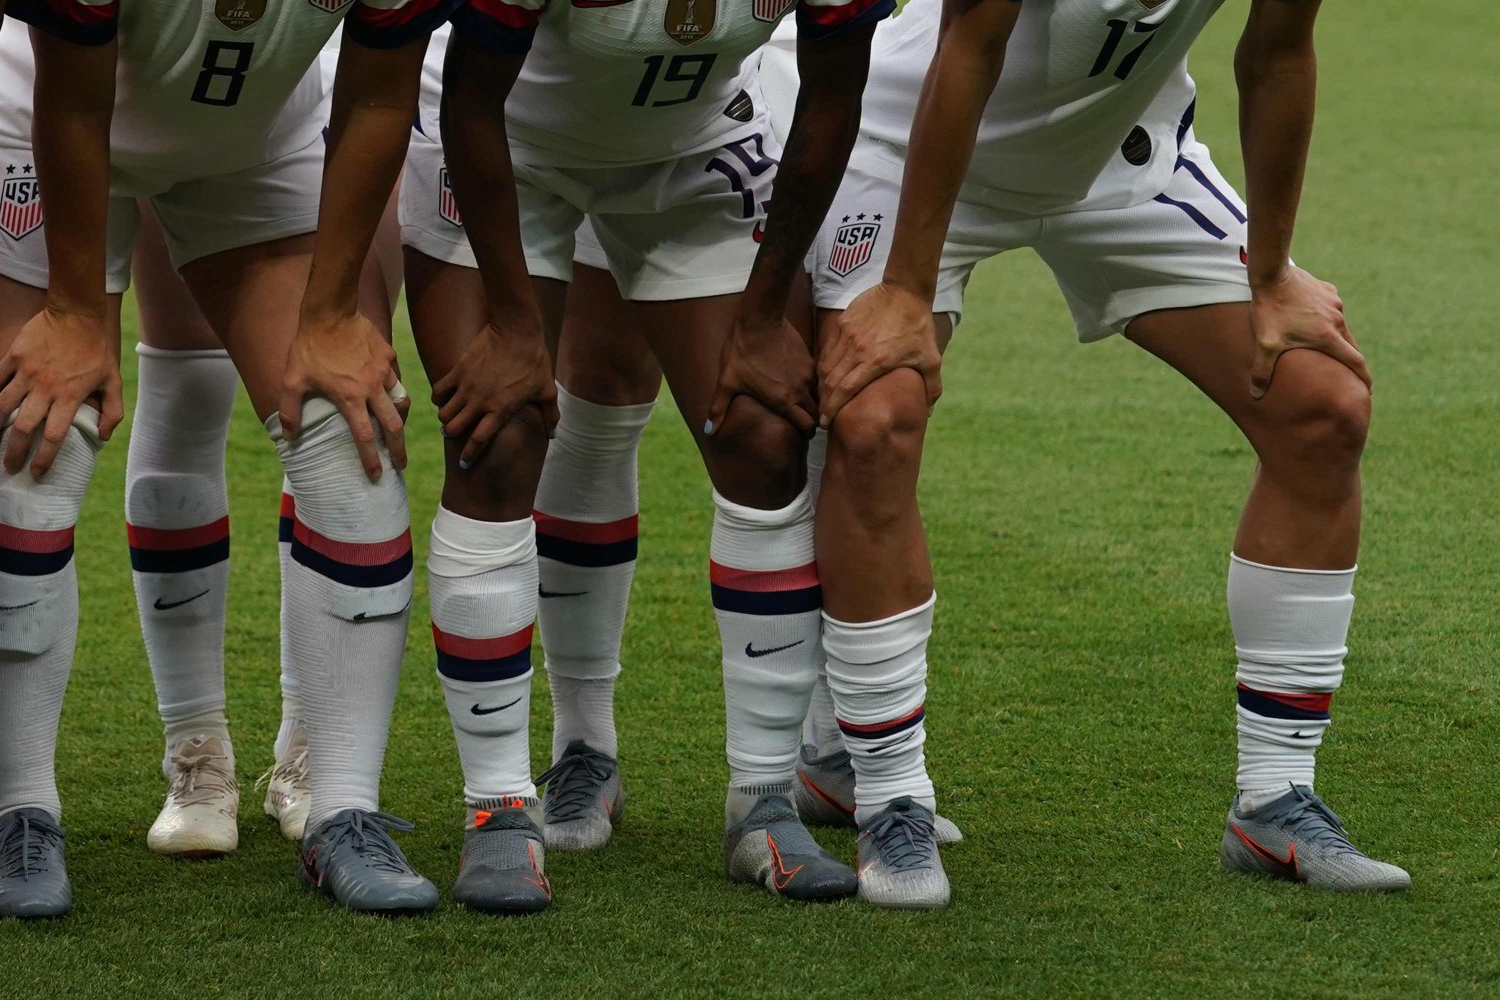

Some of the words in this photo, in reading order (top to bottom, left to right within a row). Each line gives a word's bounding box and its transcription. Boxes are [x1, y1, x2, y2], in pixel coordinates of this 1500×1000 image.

[227, 9, 251, 18] FIFA
[676, 24, 700, 32] FIFA
[1087, 19, 1167, 81] 17
[189, 40, 255, 107] 8
[630, 52, 718, 108] 19
[837, 226, 875, 246] USA
